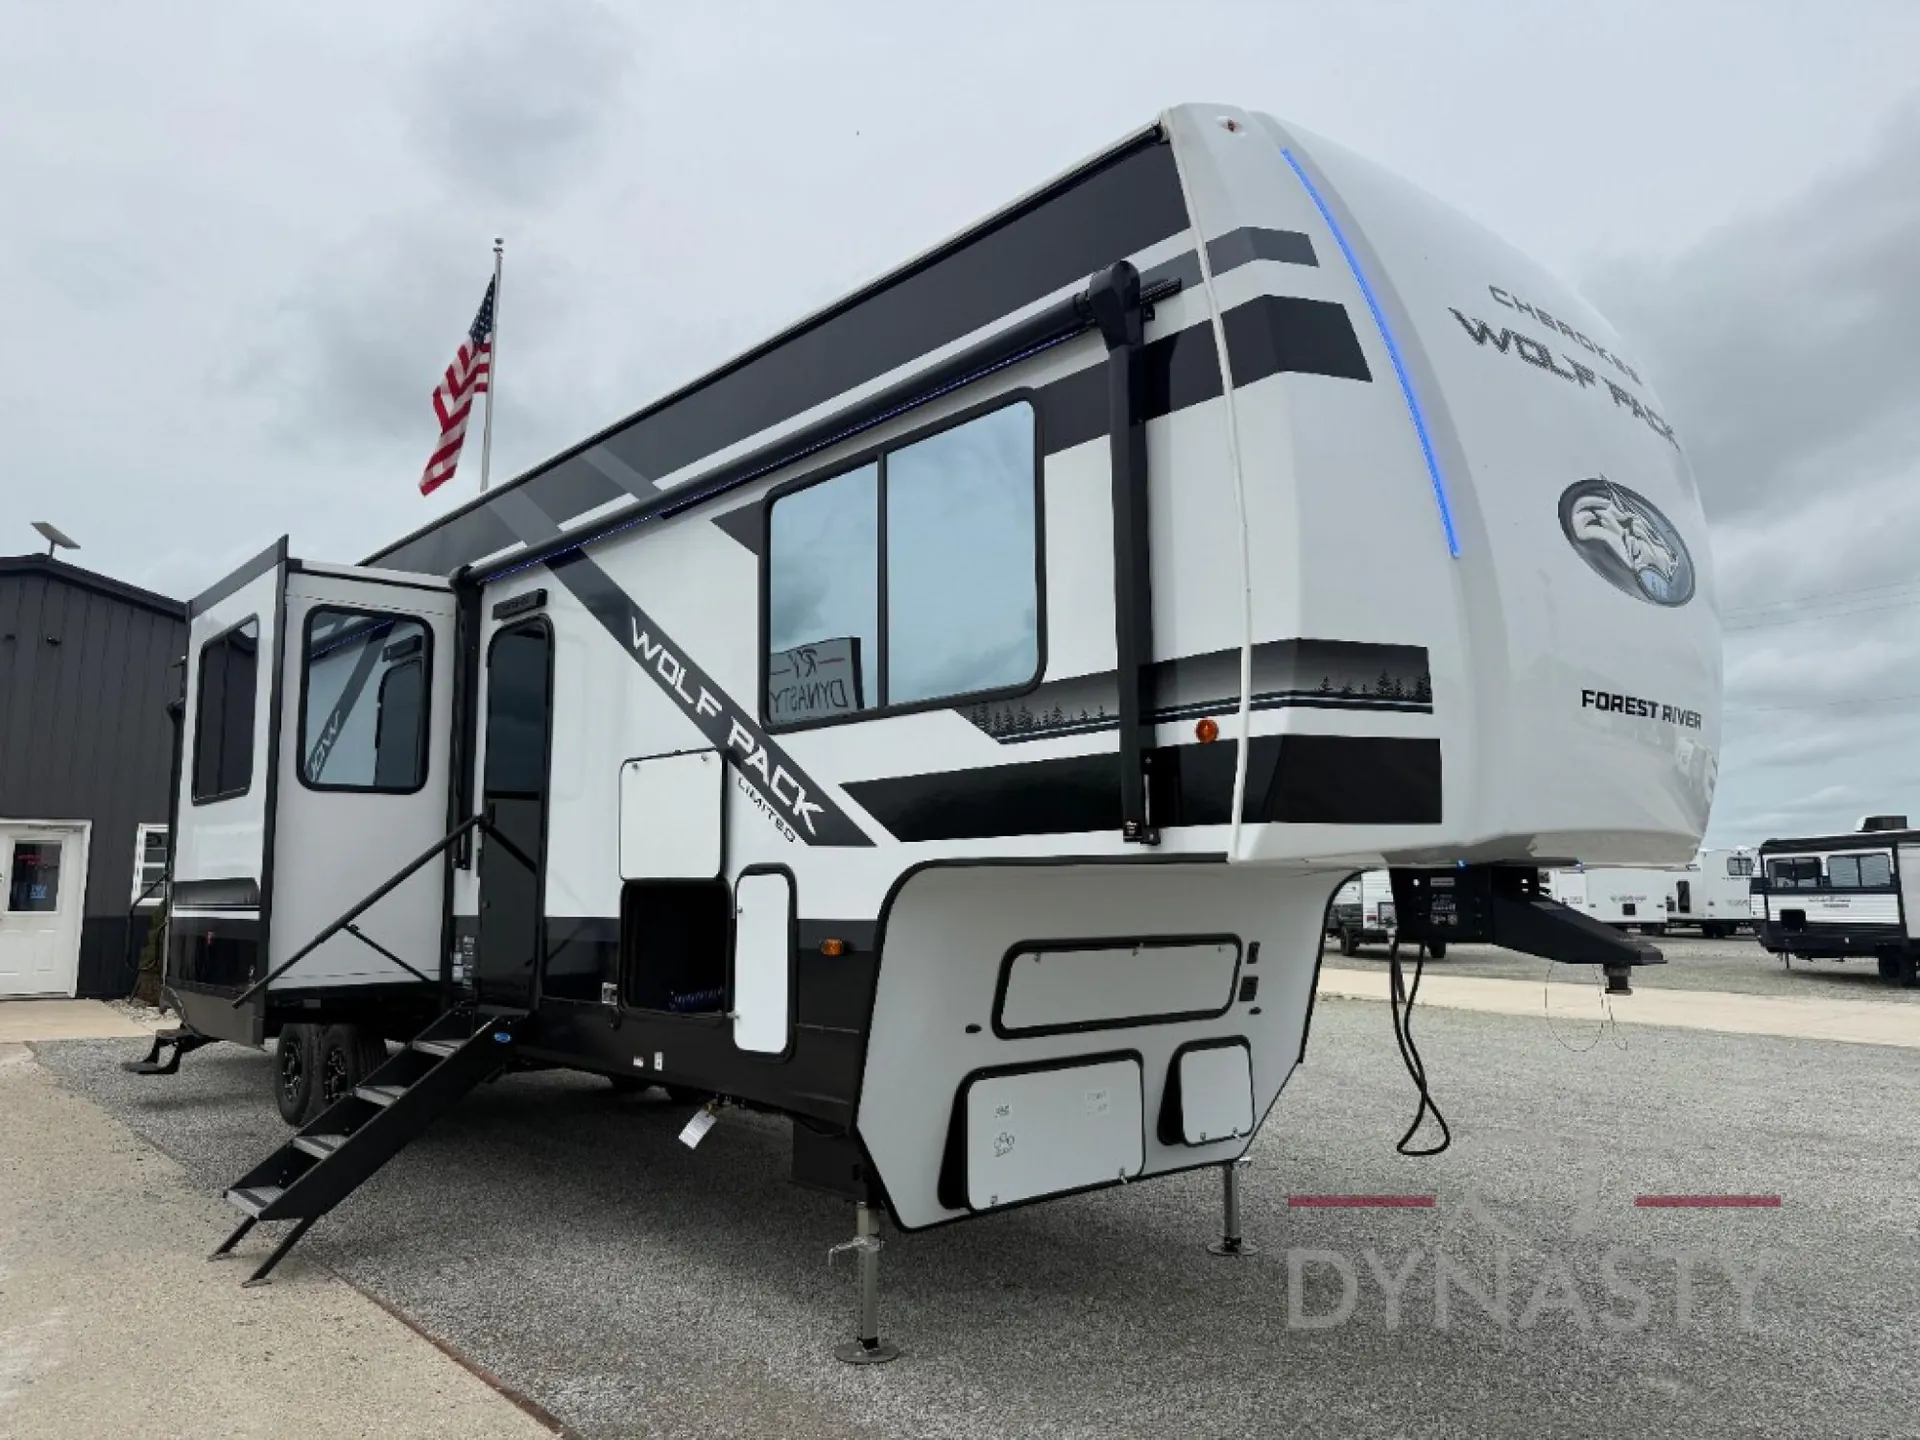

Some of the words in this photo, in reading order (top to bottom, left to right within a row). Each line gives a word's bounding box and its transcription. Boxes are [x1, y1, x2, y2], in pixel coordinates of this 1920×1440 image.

[1448, 306, 1597, 388] WOLF
[631, 616, 722, 717] WOLF
[727, 716, 825, 837] PACK
[1581, 689, 1659, 719] FOREST
[1662, 704, 1702, 731] RIVER
[738, 776, 796, 843] LIMITED
